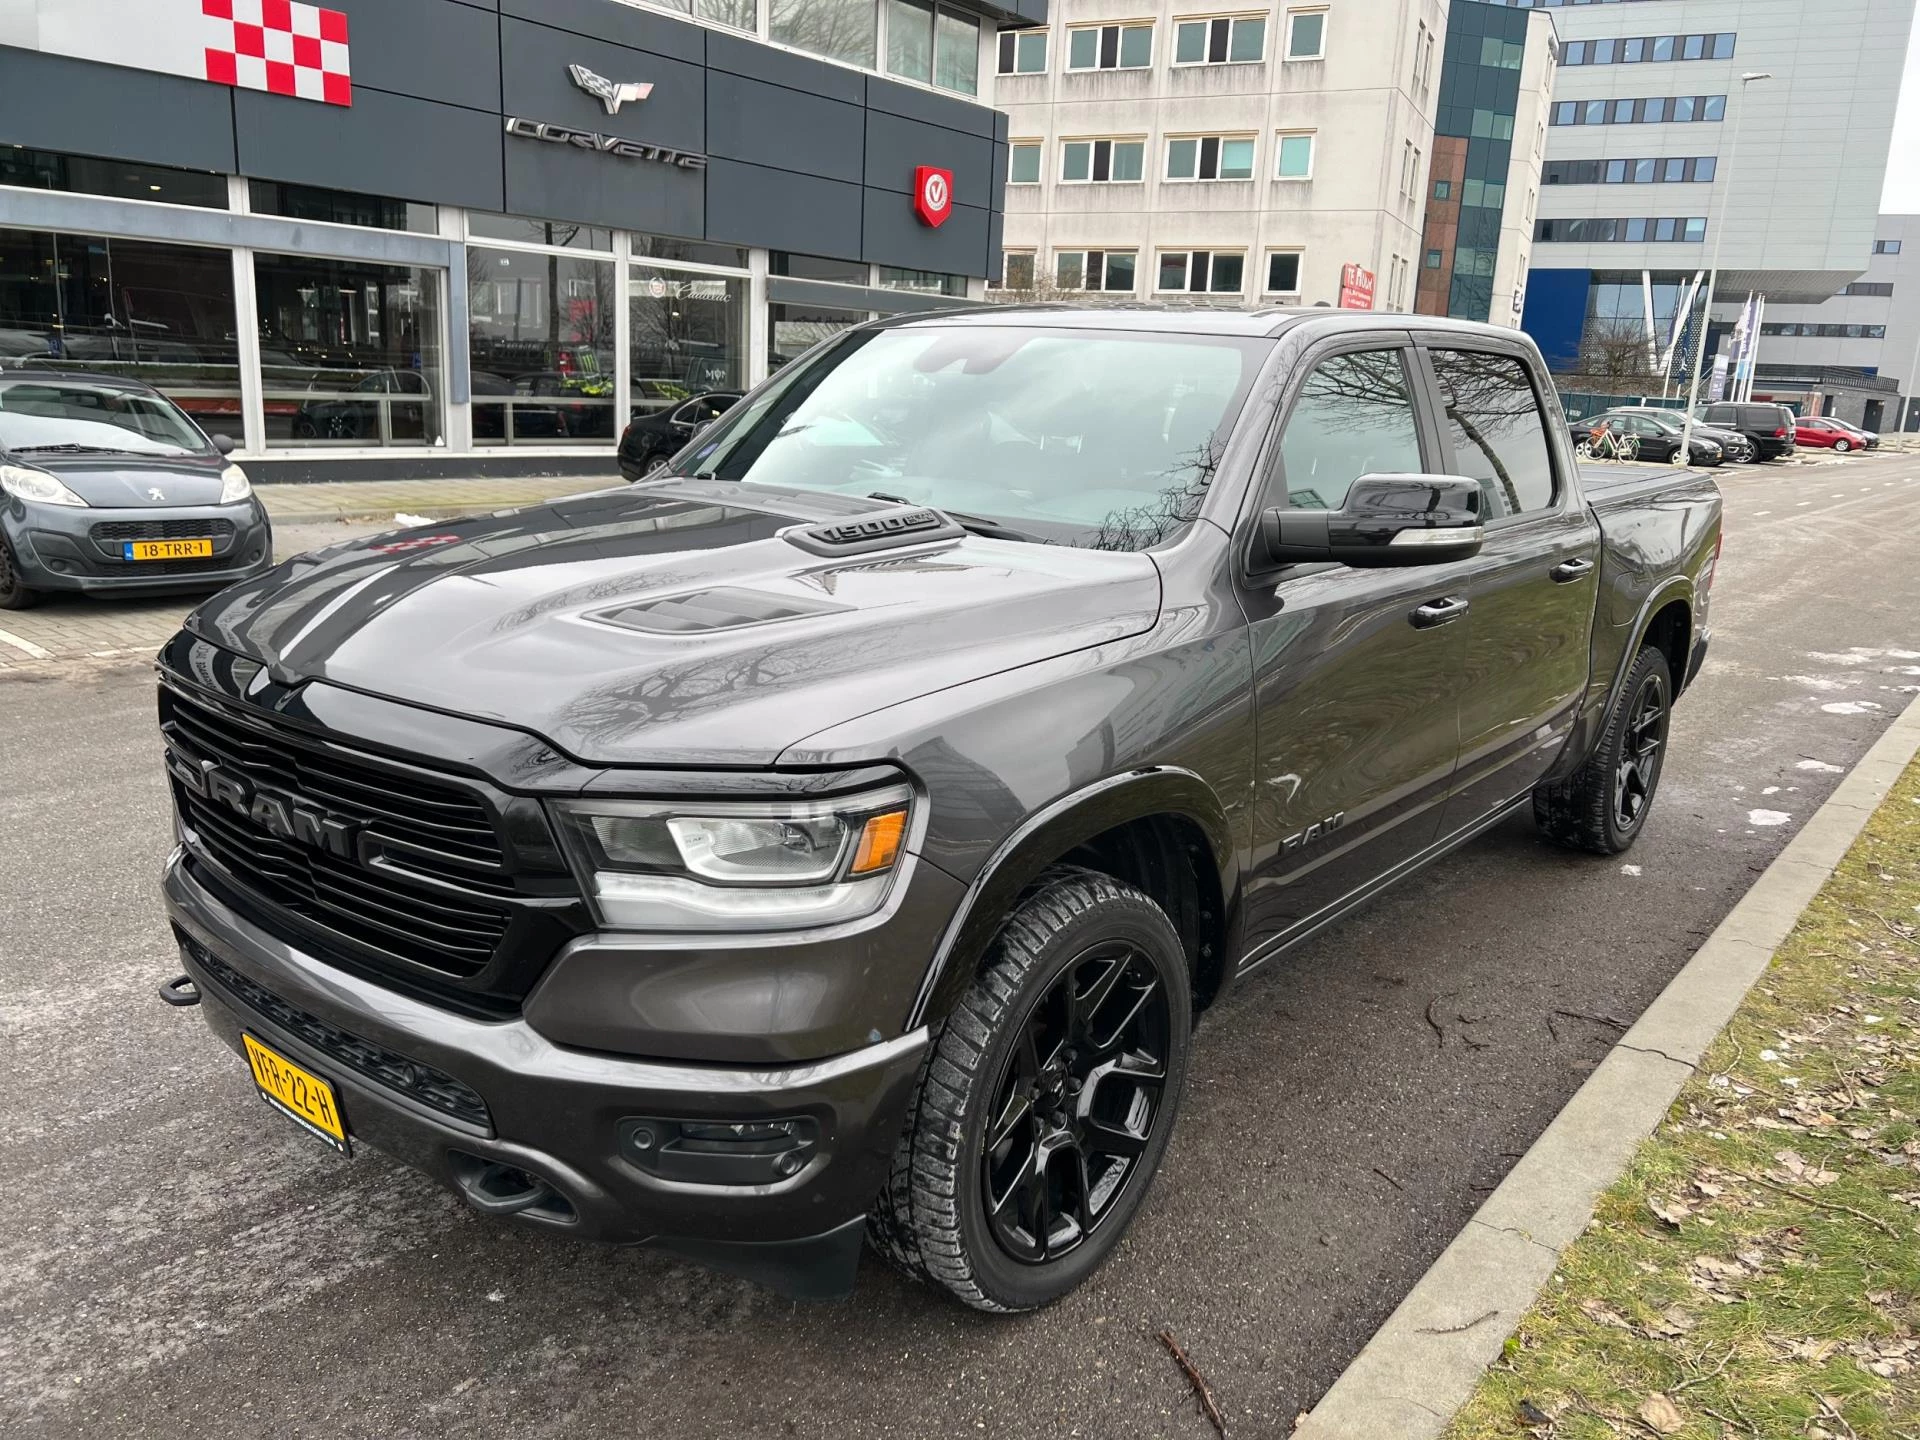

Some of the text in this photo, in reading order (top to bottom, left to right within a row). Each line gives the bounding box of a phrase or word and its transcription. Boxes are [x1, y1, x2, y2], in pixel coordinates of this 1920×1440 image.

[506, 117, 707, 168] CORVETTE
[142, 542, 204, 557] 18-TRR-1
[824, 517, 904, 541] 1500
[208, 768, 351, 860] RAM
[1278, 811, 1344, 855] RAM
